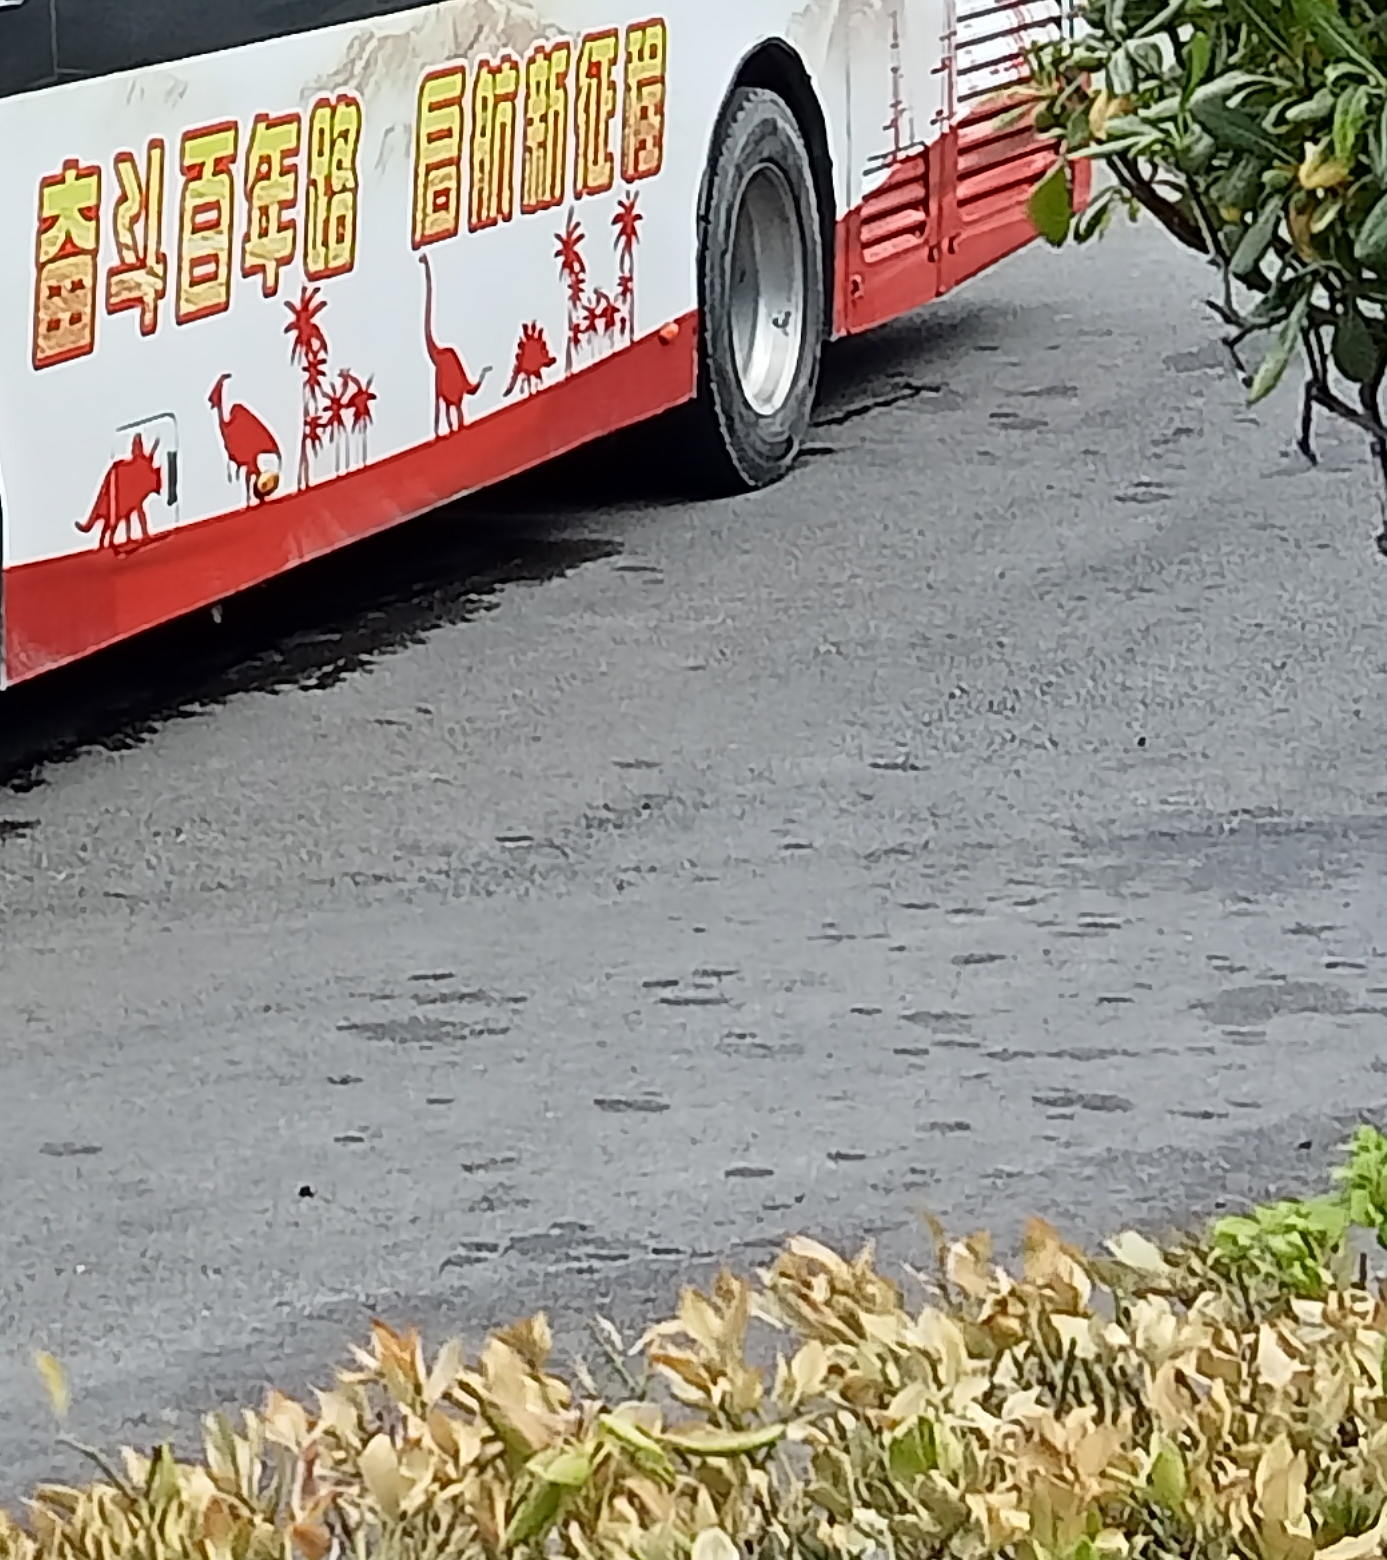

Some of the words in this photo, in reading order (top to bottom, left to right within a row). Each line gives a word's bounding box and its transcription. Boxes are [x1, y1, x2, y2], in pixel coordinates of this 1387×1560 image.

[32, 93, 363, 370] 奋斗百年路
[411, 15, 668, 252] 启航新征程
